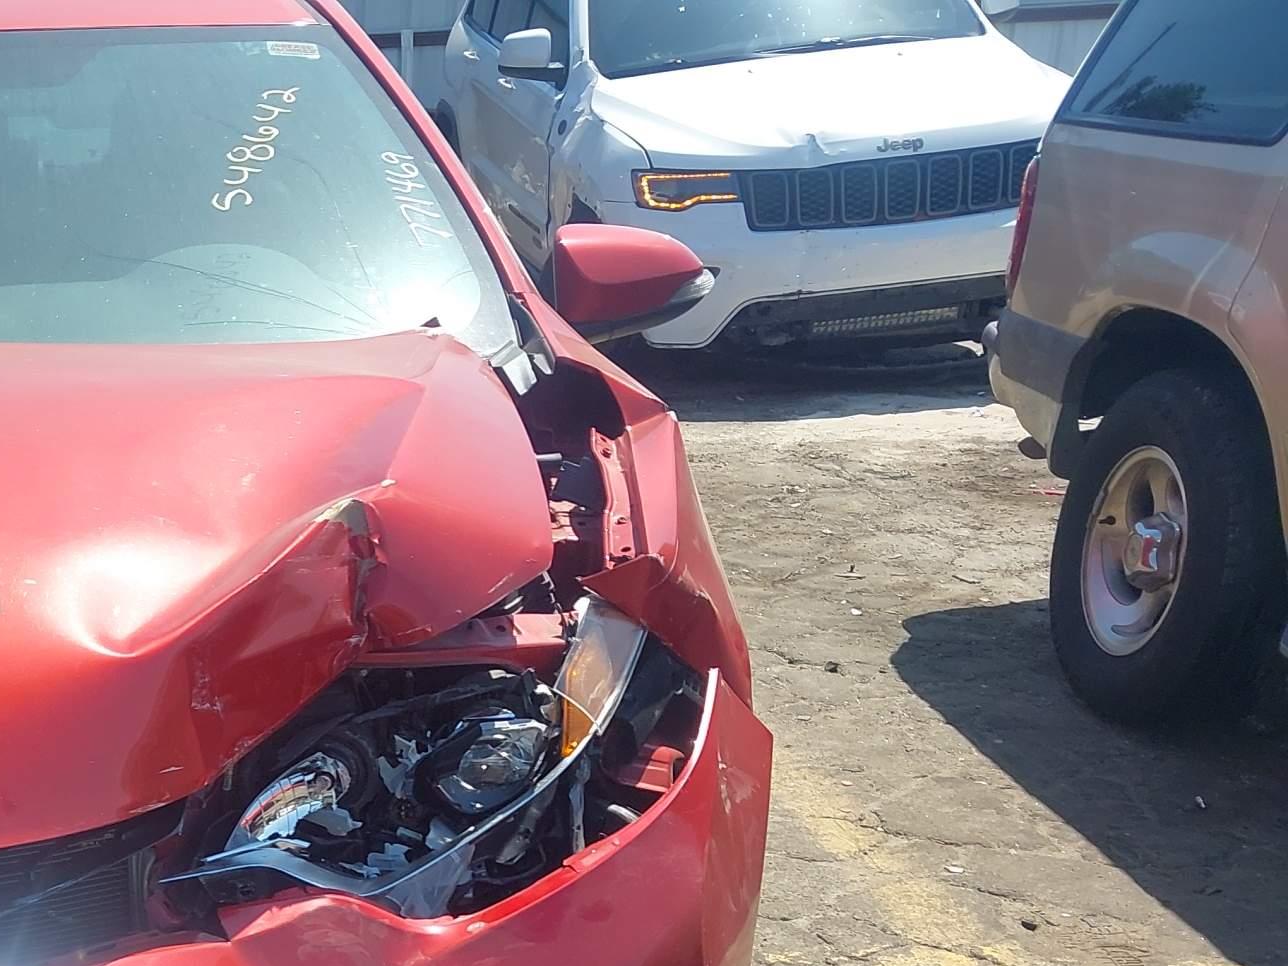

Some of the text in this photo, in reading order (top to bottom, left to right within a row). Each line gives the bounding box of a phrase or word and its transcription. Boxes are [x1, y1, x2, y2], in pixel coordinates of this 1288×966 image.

[211, 87, 300, 211] 548642
[876, 137, 924, 153] Jeep
[381, 151, 453, 247] 771469
